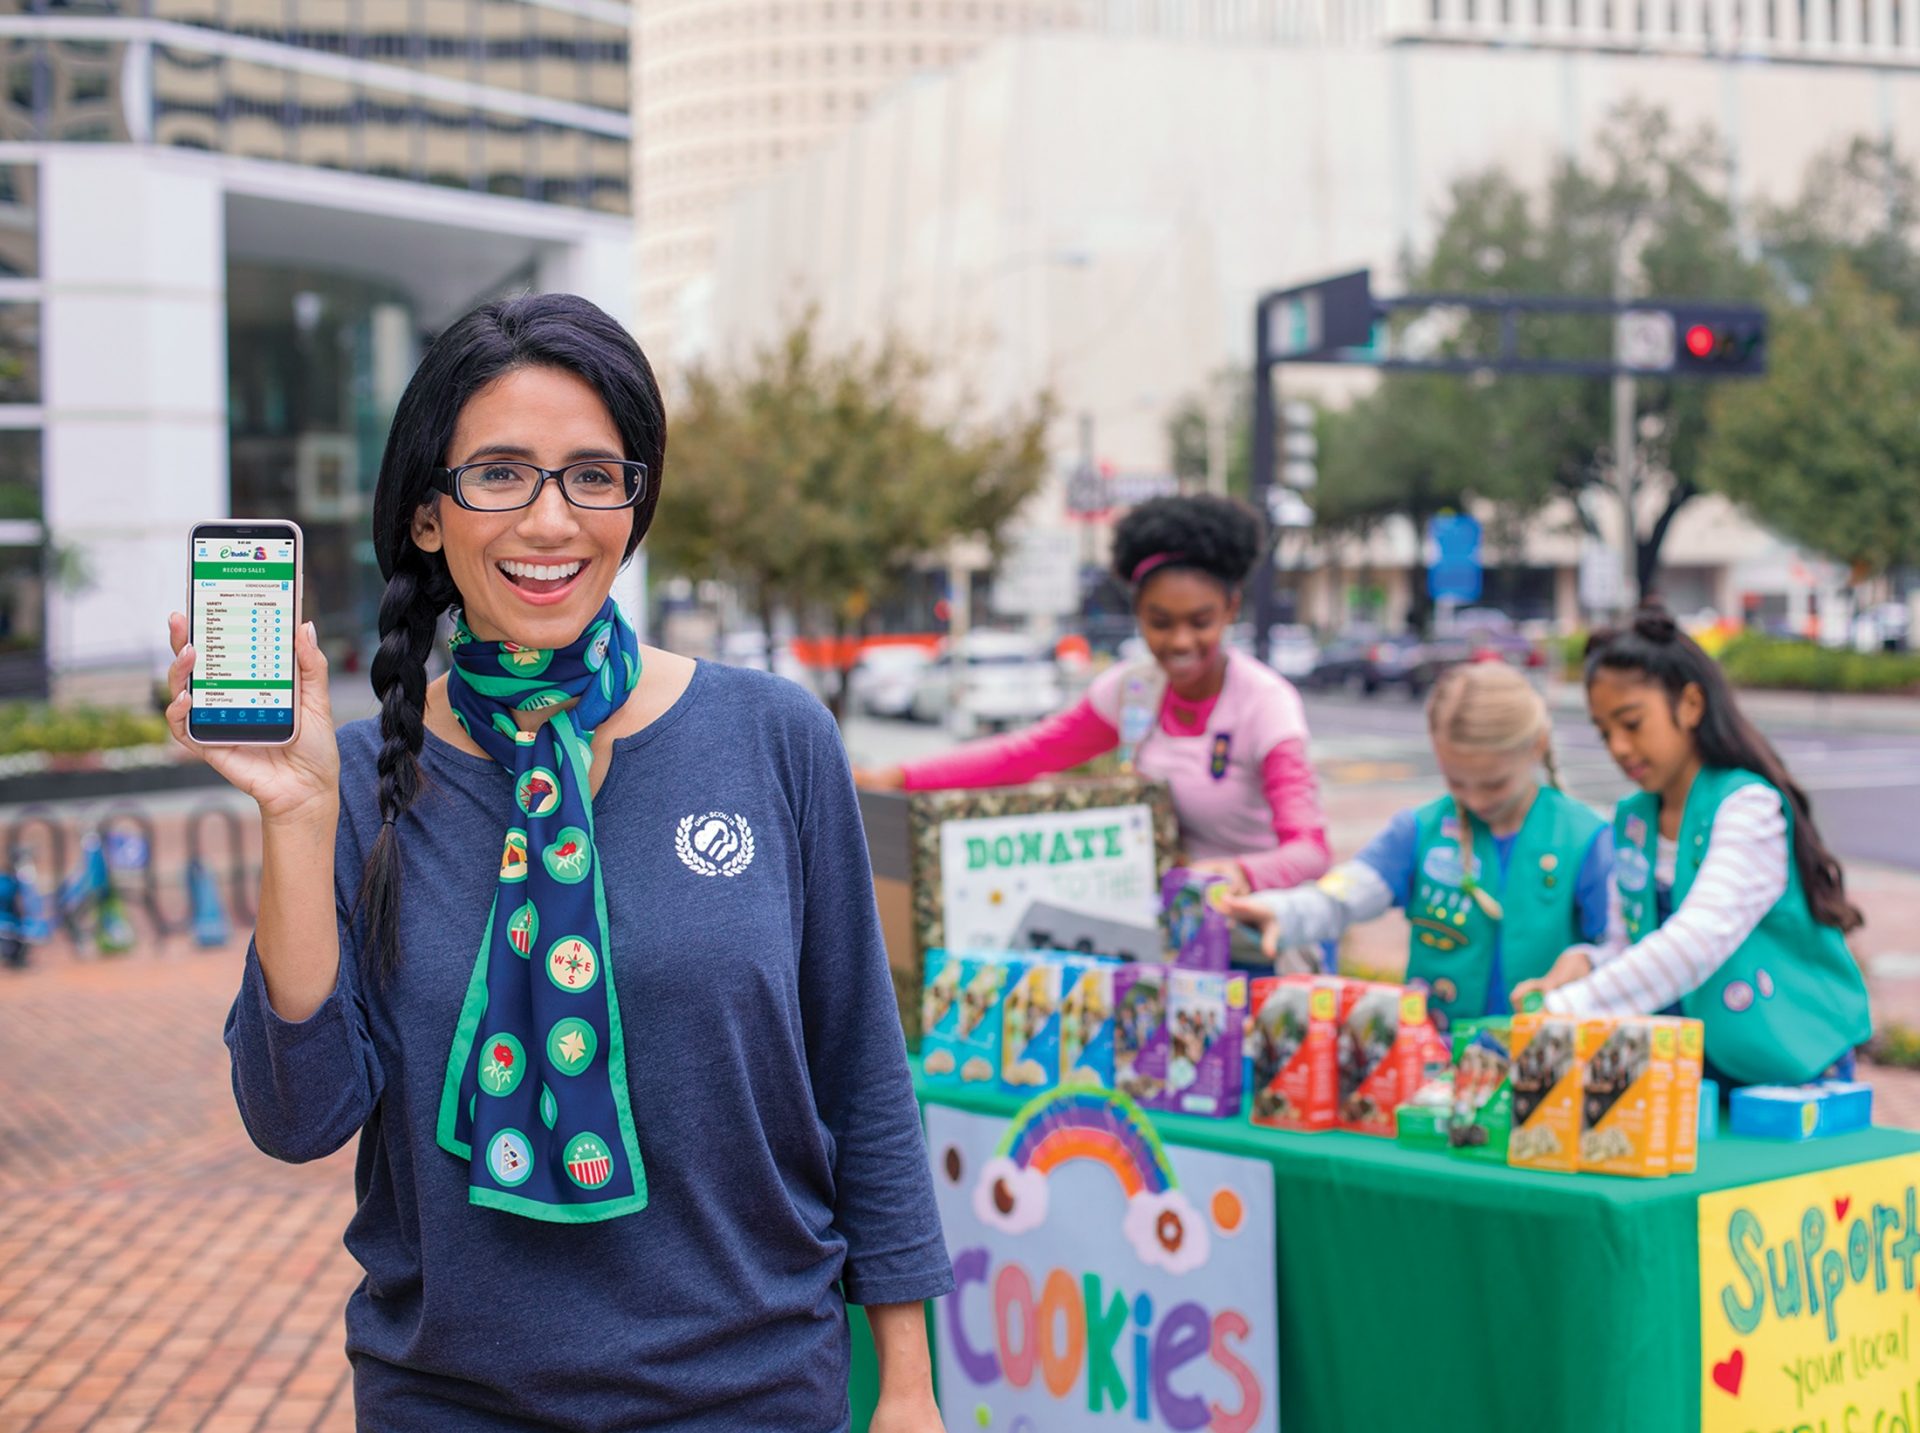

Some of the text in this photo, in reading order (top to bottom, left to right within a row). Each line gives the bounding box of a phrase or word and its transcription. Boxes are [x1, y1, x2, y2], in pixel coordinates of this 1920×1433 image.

[966, 826, 1124, 870] DONATE
[573, 942, 582, 953] N
[554, 954, 565, 965] W
[584, 962, 592, 972] E
[567, 975, 575, 985] S
